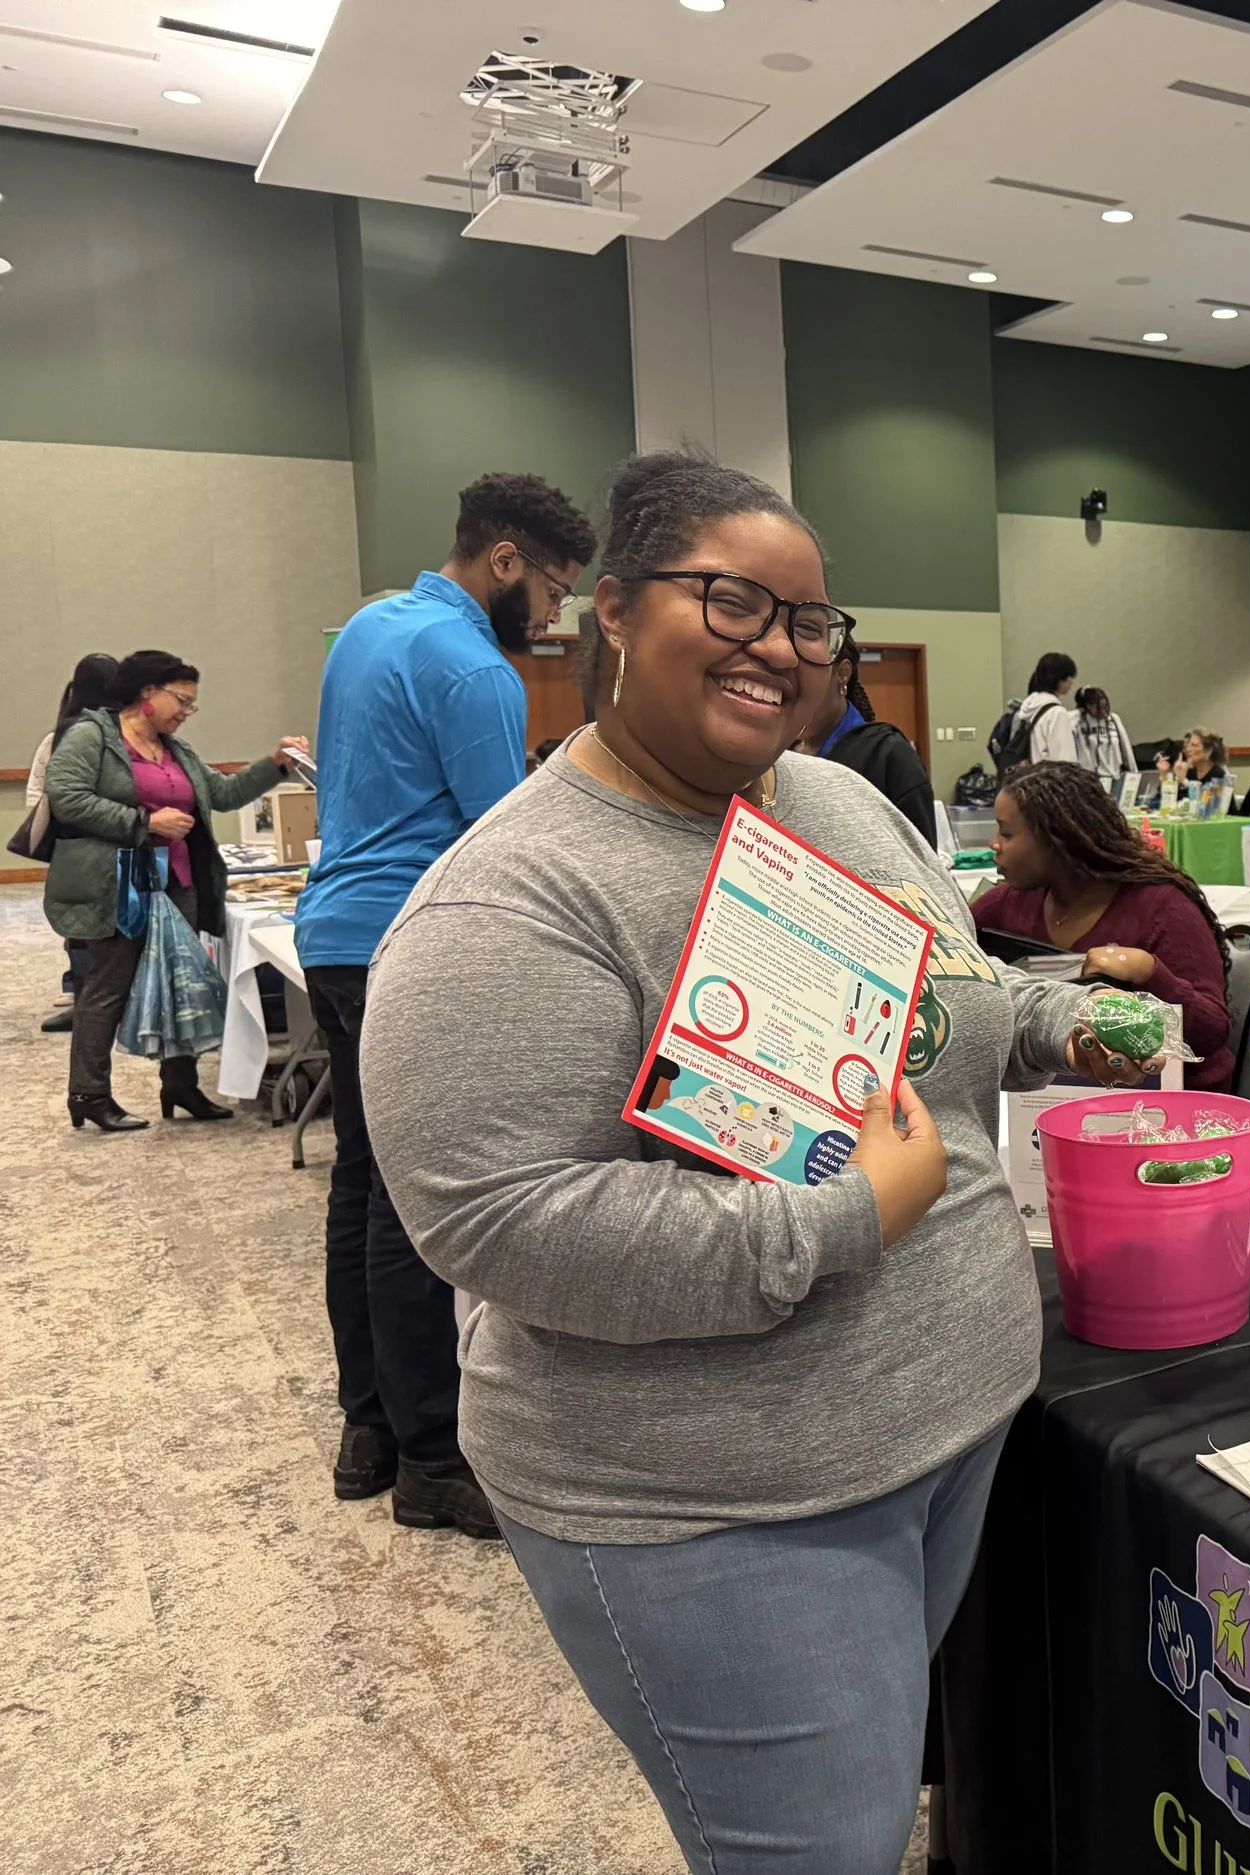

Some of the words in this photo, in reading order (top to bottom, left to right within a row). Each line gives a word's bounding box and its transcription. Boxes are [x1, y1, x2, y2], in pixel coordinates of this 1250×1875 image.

[731, 835, 753, 852] and
[756, 849, 794, 882] Vaping
[735, 818, 799, 865] E-cigarettes
[766, 909, 791, 929] WHAT
[791, 925, 800, 934] IS
[800, 930, 813, 942] AN
[813, 938, 866, 975] E-CIGARETTE?
[770, 1003, 781, 1012] BY
[780, 1009, 793, 1019] THE
[792, 1015, 825, 1038] NUMBERS:
[675, 1054, 688, 1063] not
[688, 1060, 702, 1070] just
[703, 1067, 723, 1081] water
[724, 1077, 746, 1091] vapor!
[726, 1052, 747, 1067] WHAT
[747, 1063, 753, 1071] IS
[754, 1066, 762, 1075] IN
[763, 1071, 804, 1096] E-CIGARETTE
[805, 1092, 835, 1113] AEROSOL?
[817, 1141, 833, 1156] highly
[817, 1153, 827, 1161] and
[827, 1136, 849, 1151] Nicotine
